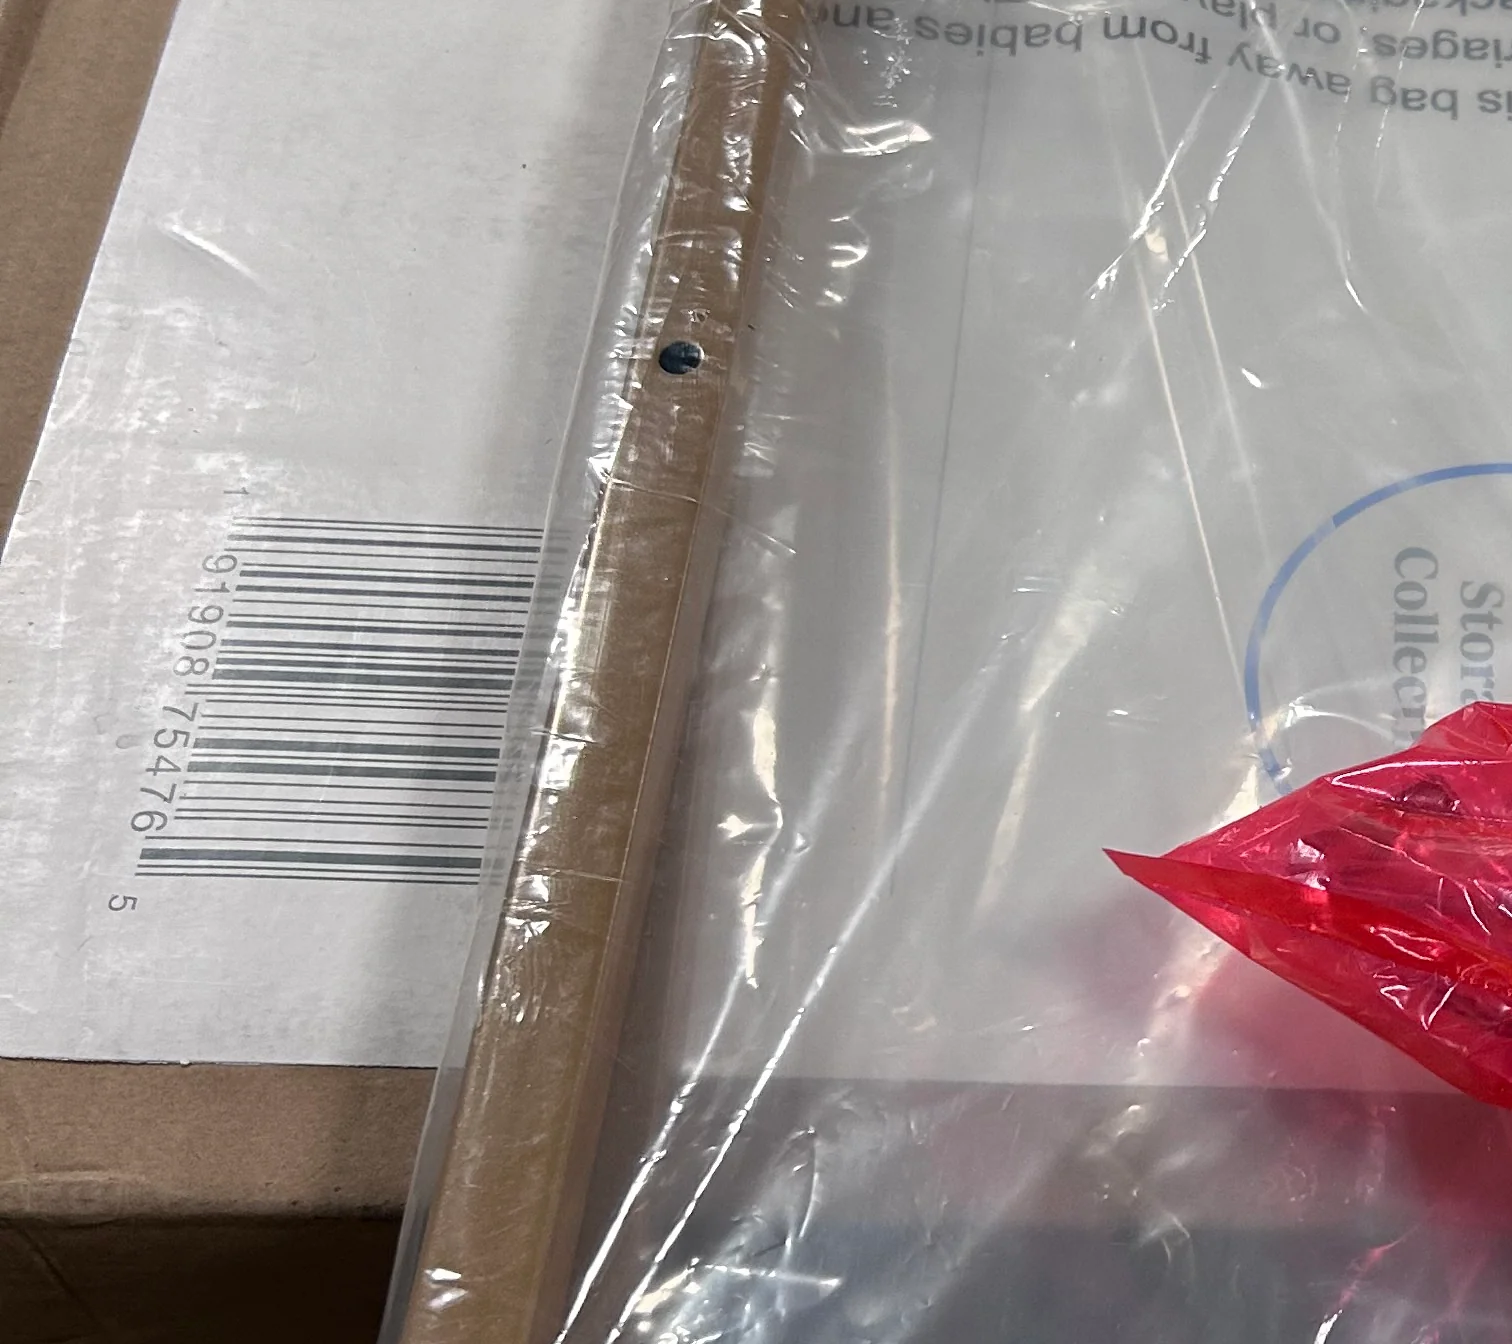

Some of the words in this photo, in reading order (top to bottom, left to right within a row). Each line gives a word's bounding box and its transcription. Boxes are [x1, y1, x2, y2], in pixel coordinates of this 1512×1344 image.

[914, 14, 1084, 57] babies
[1104, 14, 1212, 65] from
[1368, 75, 1459, 121] bag
[173, 553, 239, 678] 91908
[129, 701, 200, 834] 75476
[107, 894, 138, 912] 5
